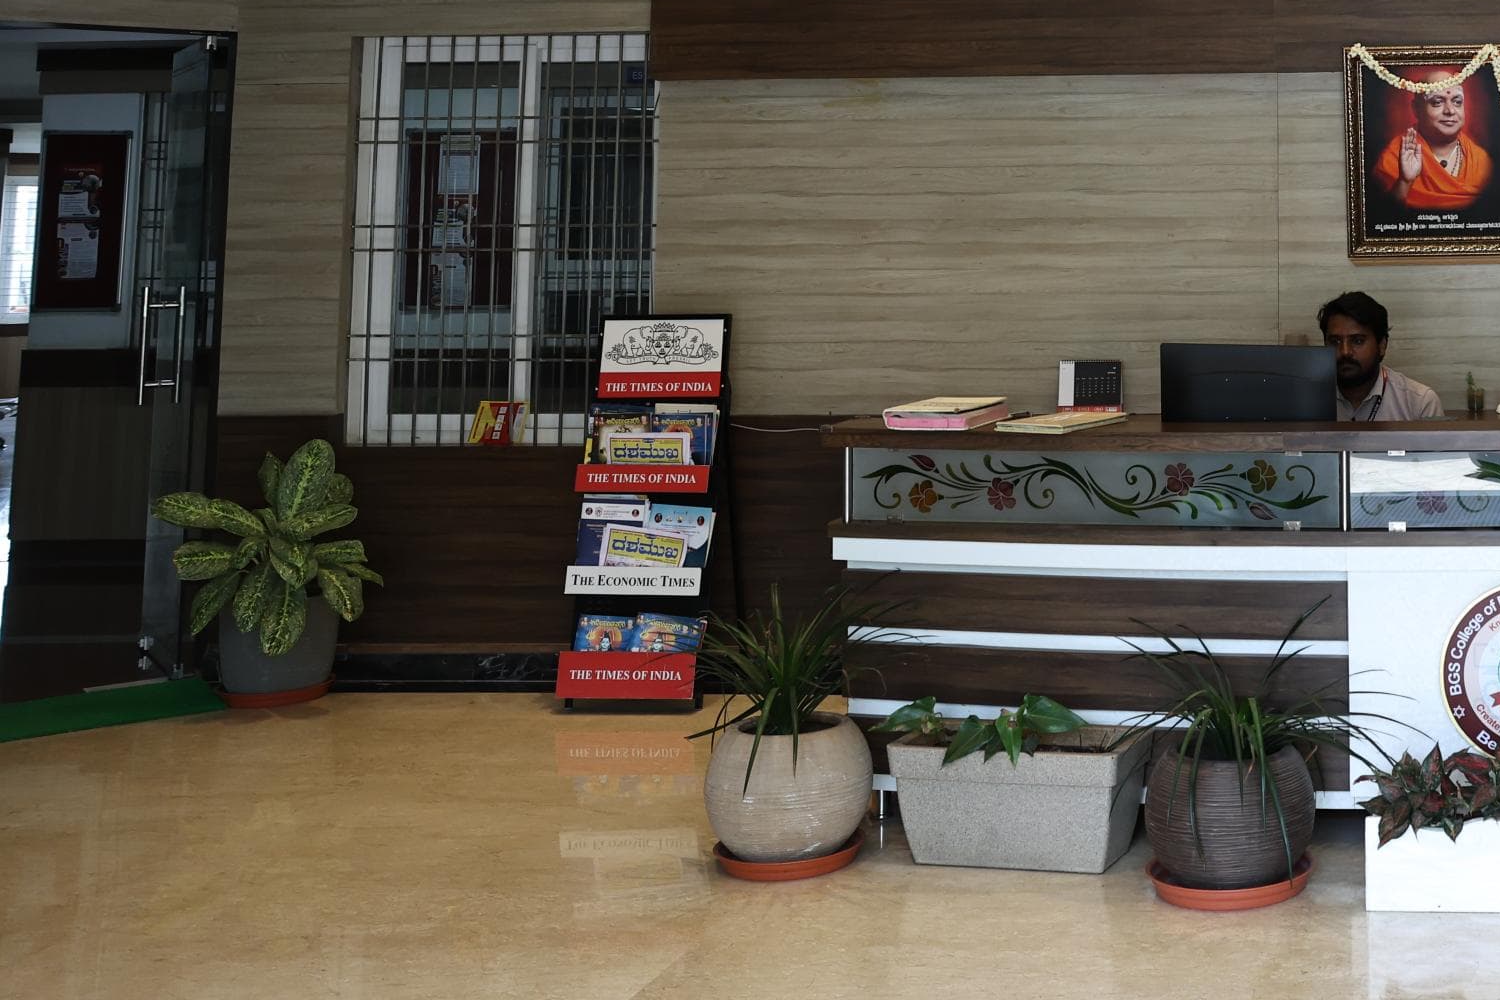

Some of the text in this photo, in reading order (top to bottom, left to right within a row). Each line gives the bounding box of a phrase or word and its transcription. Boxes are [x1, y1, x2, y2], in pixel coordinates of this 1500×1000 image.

[605, 382, 713, 392] THE TIMES OF INDIA
[613, 443, 679, 459] ದಶಮುಖ
[587, 473, 696, 484] THE TIMES OF INDIA
[612, 536, 679, 559] ದಶಮುಖ
[572, 574, 695, 588] THE ECONOMIC TIMES
[1483, 599, 1498, 615] of
[1451, 613, 1484, 660] College
[569, 670, 682, 681] THE TIMES OF INDIA
[1448, 662, 1462, 696] BGS
[1476, 704, 1500, 733] Create,
